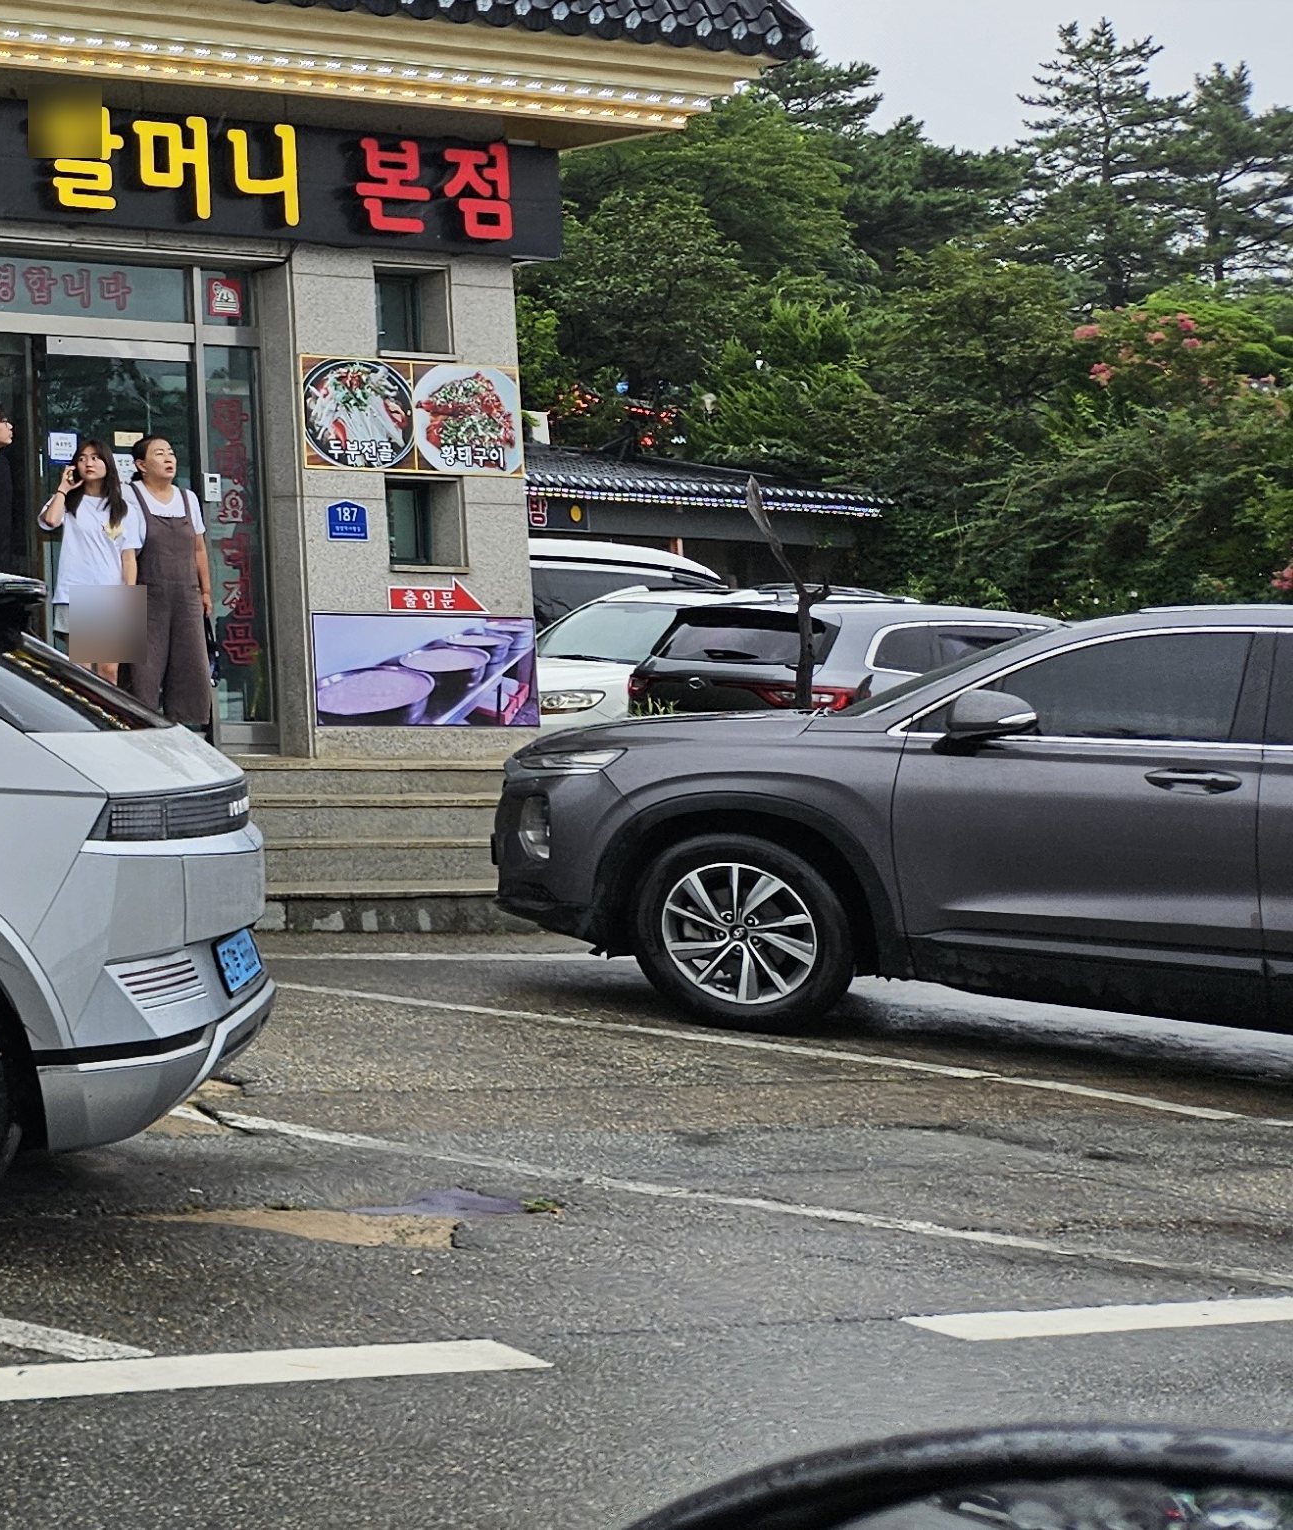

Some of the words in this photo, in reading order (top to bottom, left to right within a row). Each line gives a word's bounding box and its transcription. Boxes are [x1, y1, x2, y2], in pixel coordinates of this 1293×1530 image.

[356, 137, 514, 240] 본점
[327, 440, 395, 464] 두부전골
[440, 445, 506, 471] 황태구이
[335, 506, 358, 522] 187
[402, 589, 456, 609] 출입문
